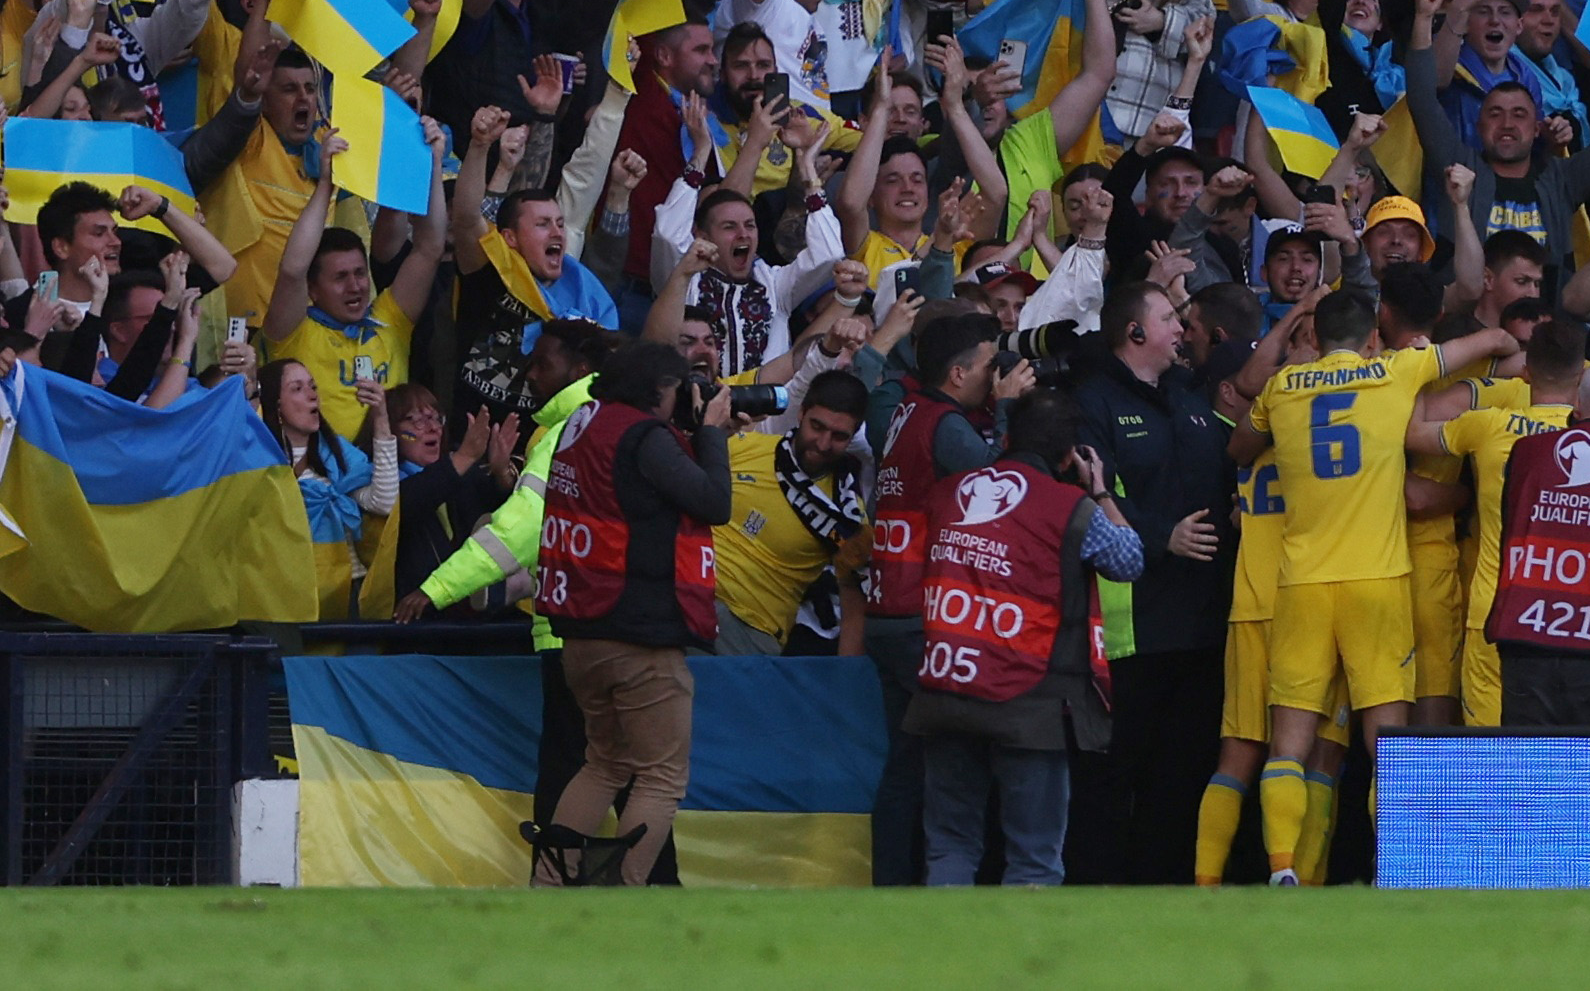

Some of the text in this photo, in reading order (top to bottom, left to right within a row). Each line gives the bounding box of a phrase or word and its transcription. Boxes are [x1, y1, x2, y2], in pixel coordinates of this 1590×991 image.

[1310, 392, 1362, 480] 6
[939, 528, 1008, 556] EUROPEAN
[930, 544, 1012, 577] QUALIFIERS
